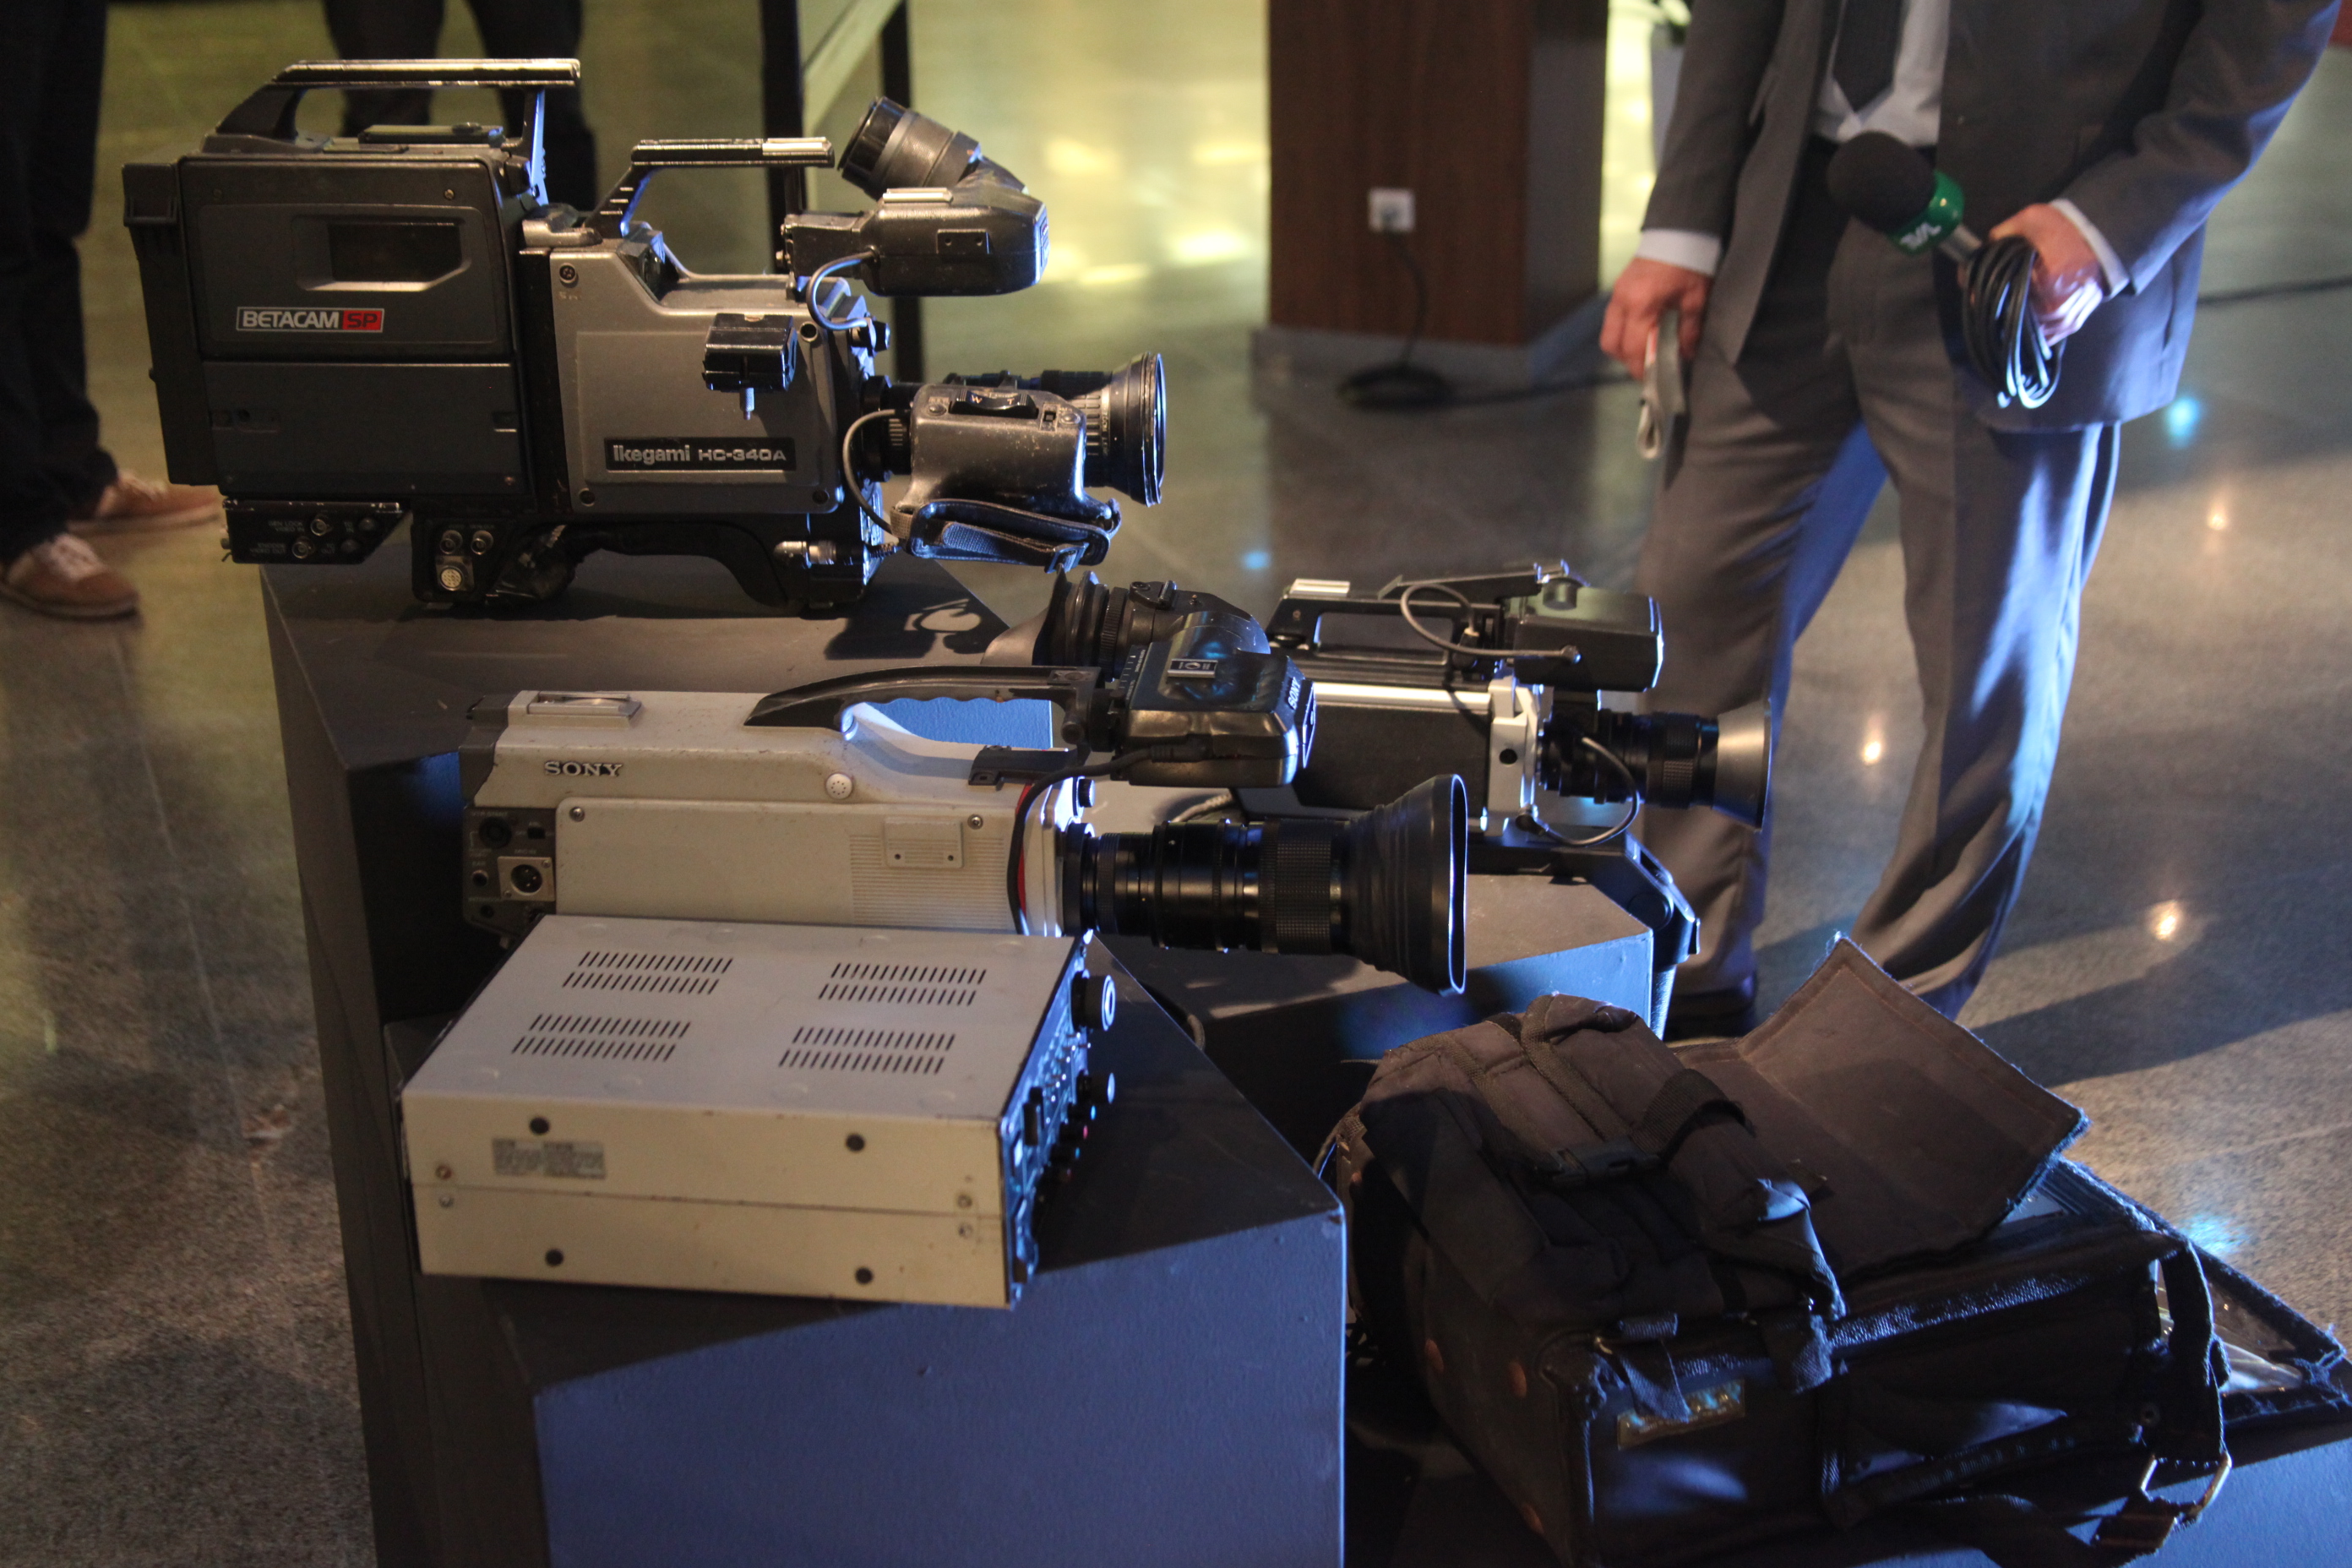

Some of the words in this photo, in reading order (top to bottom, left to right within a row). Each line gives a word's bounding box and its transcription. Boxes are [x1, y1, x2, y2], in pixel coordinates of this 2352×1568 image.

[242, 310, 340, 329] BETACAM
[347, 313, 378, 329] SP
[970, 395, 983, 404] W
[612, 444, 691, 465] Ikegami
[698, 449, 787, 461] HC-340A
[1288, 676, 1301, 710] SONY
[543, 760, 623, 777] SONY
